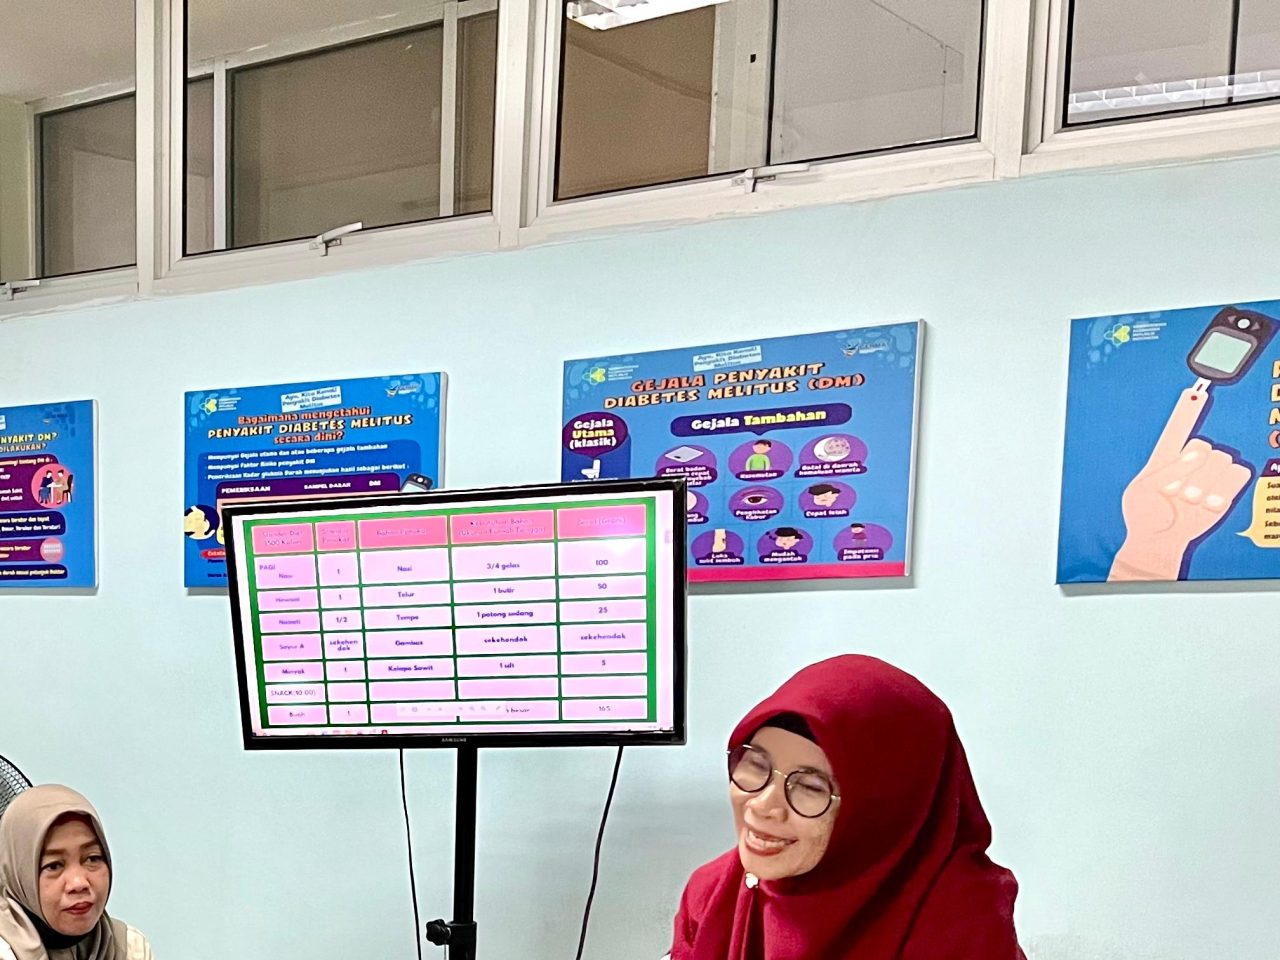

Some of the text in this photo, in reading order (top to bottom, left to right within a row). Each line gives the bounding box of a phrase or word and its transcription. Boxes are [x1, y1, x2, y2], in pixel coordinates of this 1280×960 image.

[631, 362, 826, 392] GEJALA PENYAKIT
[604, 373, 865, 409] DIABETES MELITUS (DM)
[238, 406, 371, 426] Bagaimana mengetahui
[691, 410, 827, 431] Gejala Tambahan
[208, 414, 413, 439] PENYAKIT DIABETES MELITUS
[573, 418, 614, 430] Gejala
[37, 432, 58, 441] DM?
[314, 430, 344, 442] dini?
[572, 428, 615, 439] Utama
[569, 437, 616, 449] (klasik)
[221, 485, 271, 495] PEMERIKSAAN
[369, 480, 381, 488] DM
[501, 562, 520, 570] gelas
[481, 611, 506, 619] potong
[580, 633, 626, 641] sekehendak
